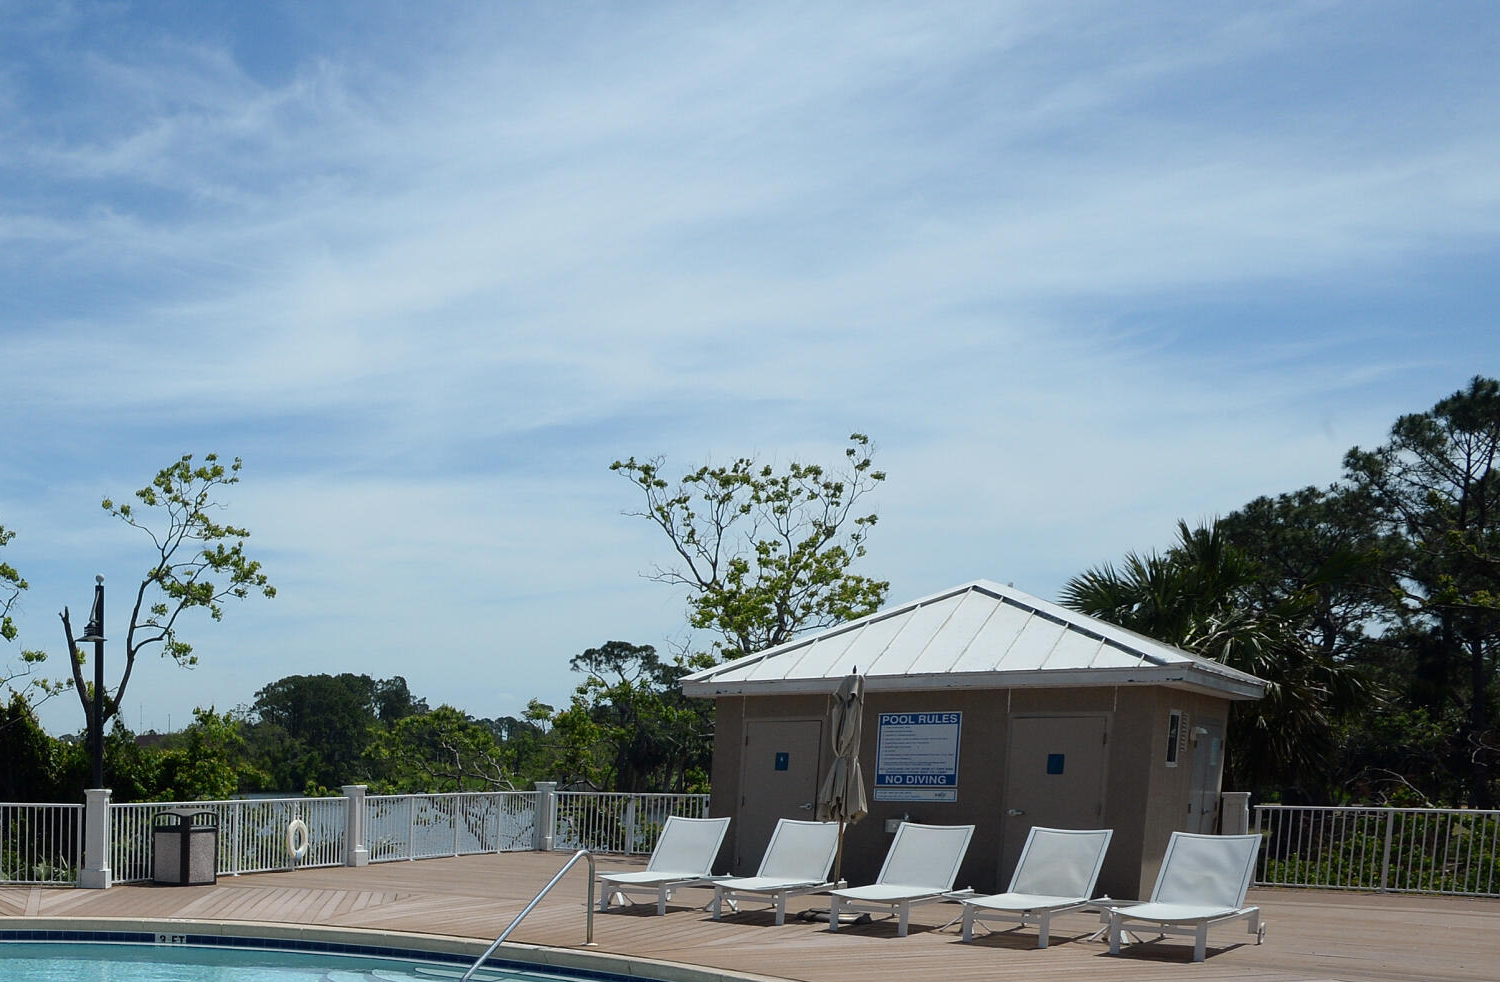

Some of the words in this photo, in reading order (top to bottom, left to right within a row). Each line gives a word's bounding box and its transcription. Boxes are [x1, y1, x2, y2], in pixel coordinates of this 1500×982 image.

[882, 715, 915, 724] POOL
[918, 714, 958, 723] RULES
[885, 775, 903, 784] NO
[906, 775, 947, 784] DIVING
